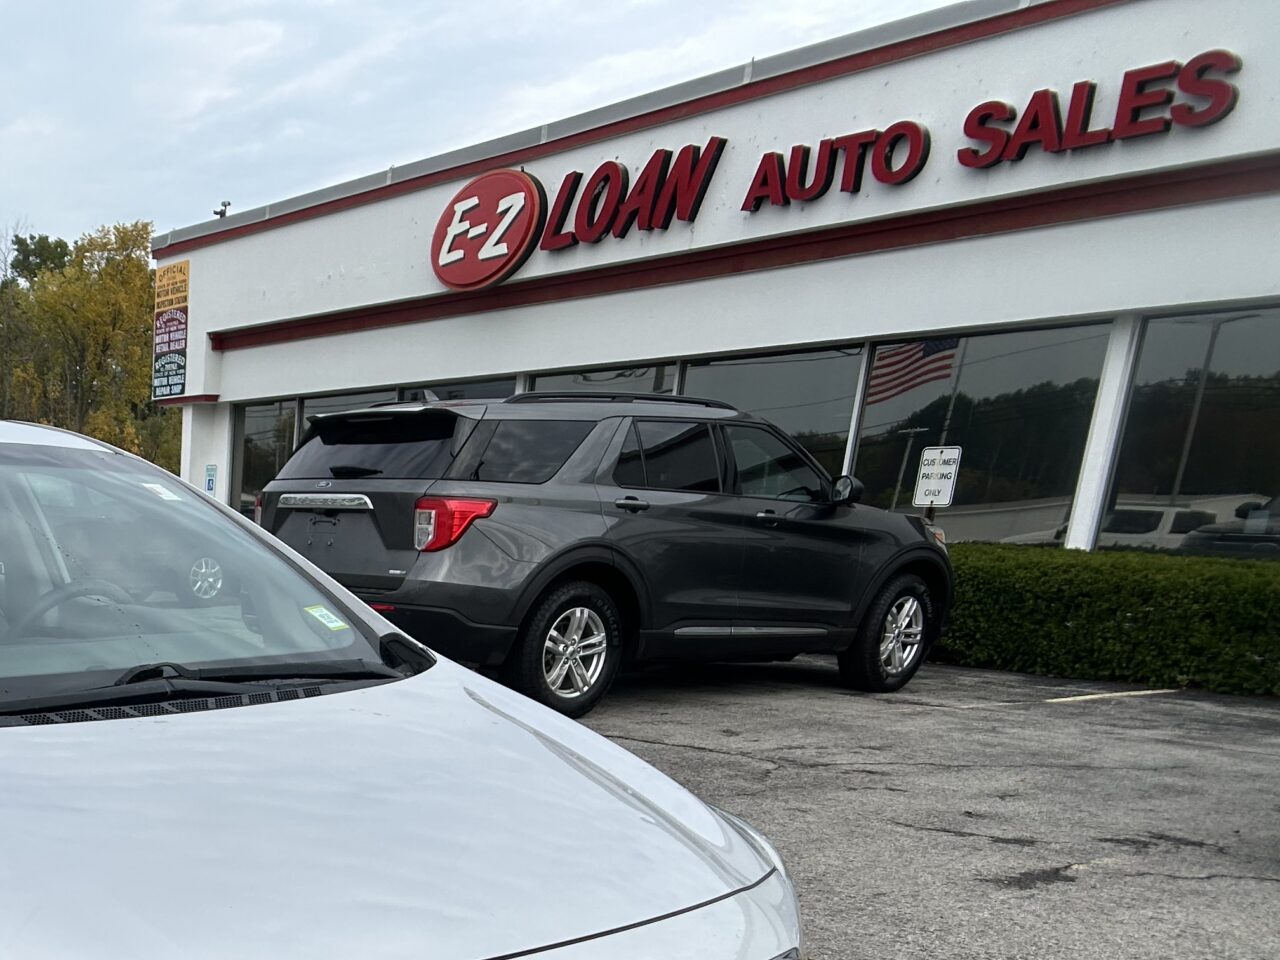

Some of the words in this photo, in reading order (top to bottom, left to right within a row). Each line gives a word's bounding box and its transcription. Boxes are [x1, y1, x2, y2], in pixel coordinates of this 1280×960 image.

[438, 192, 526, 267] E-Z
[540, 136, 728, 250] LOAN
[740, 120, 932, 211] AUTO
[957, 49, 1243, 169] SALES
[158, 264, 187, 283] OFFICIAL
[157, 289, 169, 298] MOTOR
[170, 284, 187, 295] VEHICLE
[156, 309, 187, 328] REGISTERED
[156, 333, 169, 344] MOTOR
[170, 329, 187, 341] VEHICLE
[170, 339, 186, 350] DEALER
[155, 353, 186, 370] REGISTERED
[154, 377, 168, 387] MOTOR
[169, 374, 185, 384] VEHICLE
[156, 385, 170, 396] REPAIR
[171, 384, 183, 394] SHOP
[924, 488, 942, 497] ONLY
